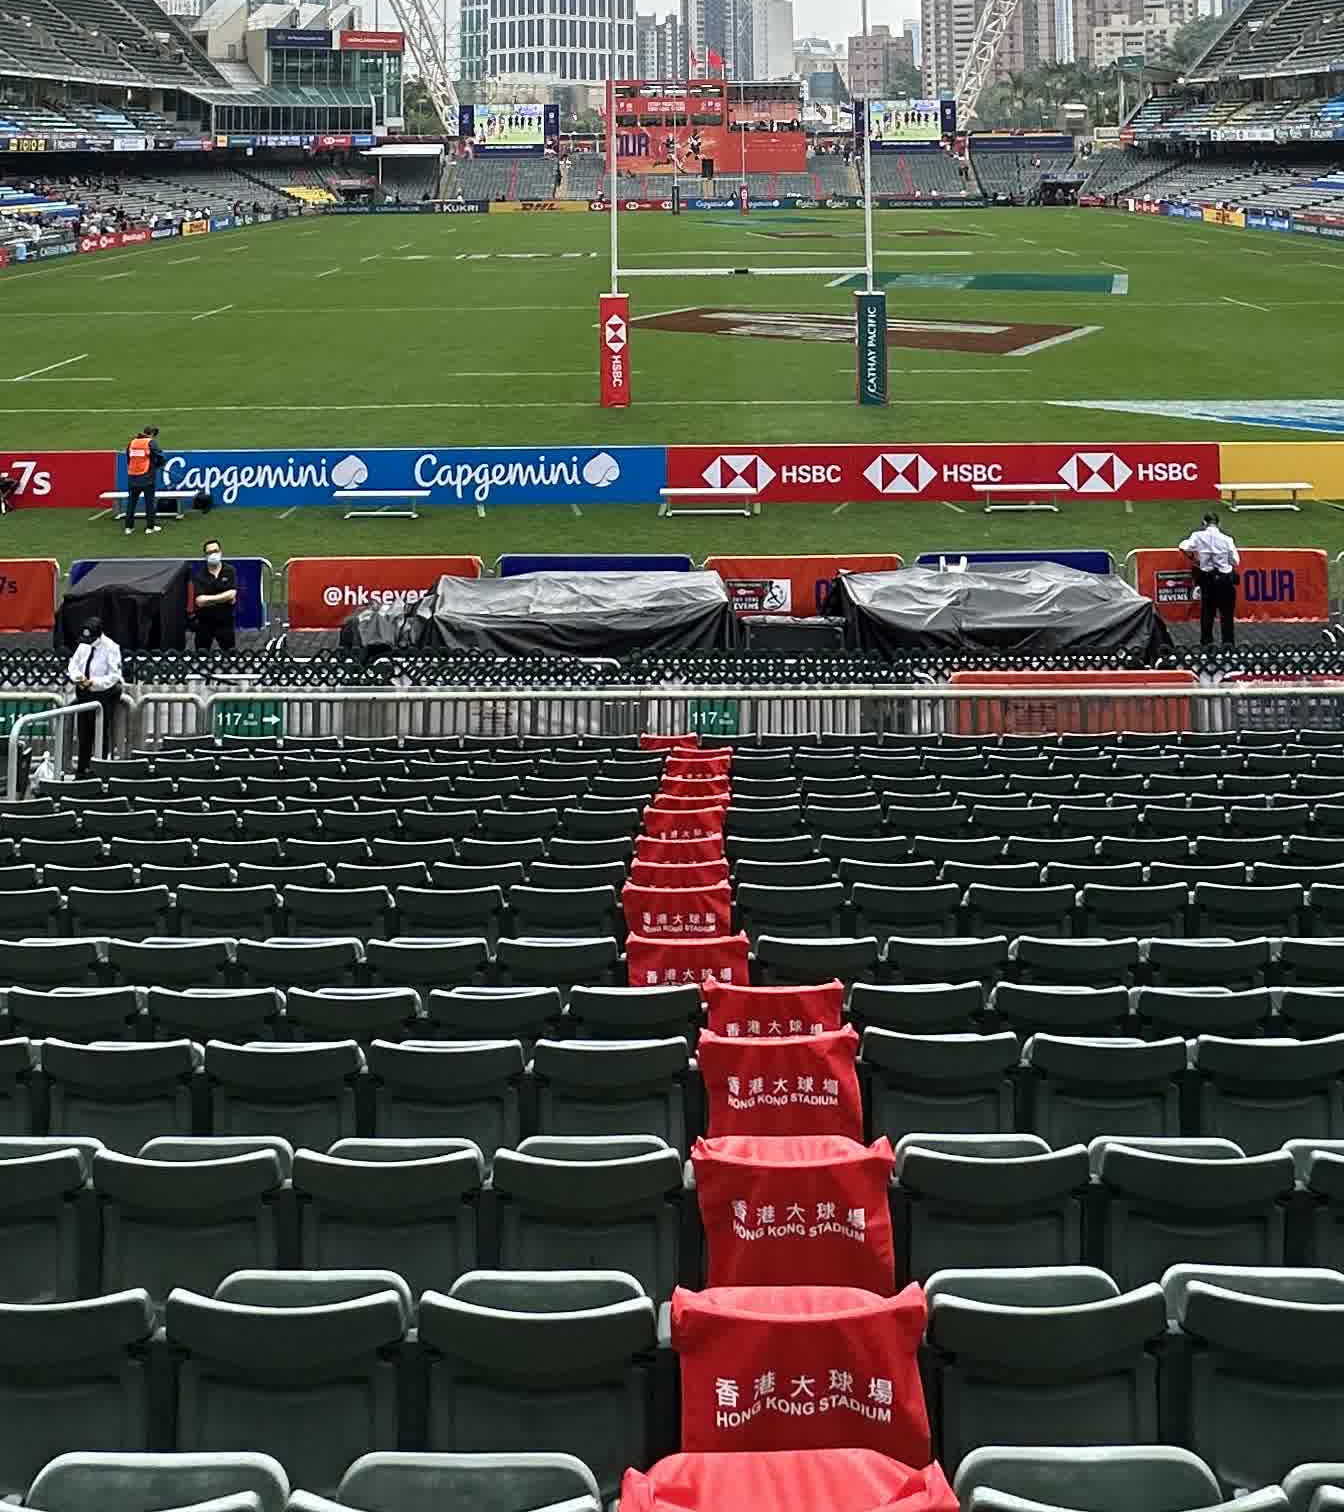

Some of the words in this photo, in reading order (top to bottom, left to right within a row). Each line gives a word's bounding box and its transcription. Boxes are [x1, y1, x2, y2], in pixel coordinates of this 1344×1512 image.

[443, 203, 479, 212] KUKRI
[867, 305, 877, 346] PACIFIC
[612, 355, 622, 387] HSBC
[867, 347, 877, 393] CATHAY
[163, 456, 329, 503] Capgemini
[414, 453, 579, 502] Capgemini
[781, 464, 841, 483] HSBC
[942, 464, 1002, 483] HSBC
[1137, 462, 1198, 481] HSBC
[1244, 569, 1296, 602] OUR
[216, 713, 241, 726] 117
[692, 711, 717, 725] 117
[727, 1075, 839, 1096] 香港大球場
[727, 1094, 756, 1110] HONG
[757, 1093, 789, 1106] KONG
[790, 1092, 838, 1107] STADIUM
[732, 1199, 865, 1229] 香港大球場
[733, 1220, 763, 1242] HONG
[767, 1223, 805, 1238] KONG
[808, 1221, 865, 1243] STADIUM
[715, 1367, 893, 1408] 香港大球場
[716, 1398, 762, 1428] HONG
[765, 1396, 816, 1417] KONG
[820, 1394, 892, 1424] STADIUM
